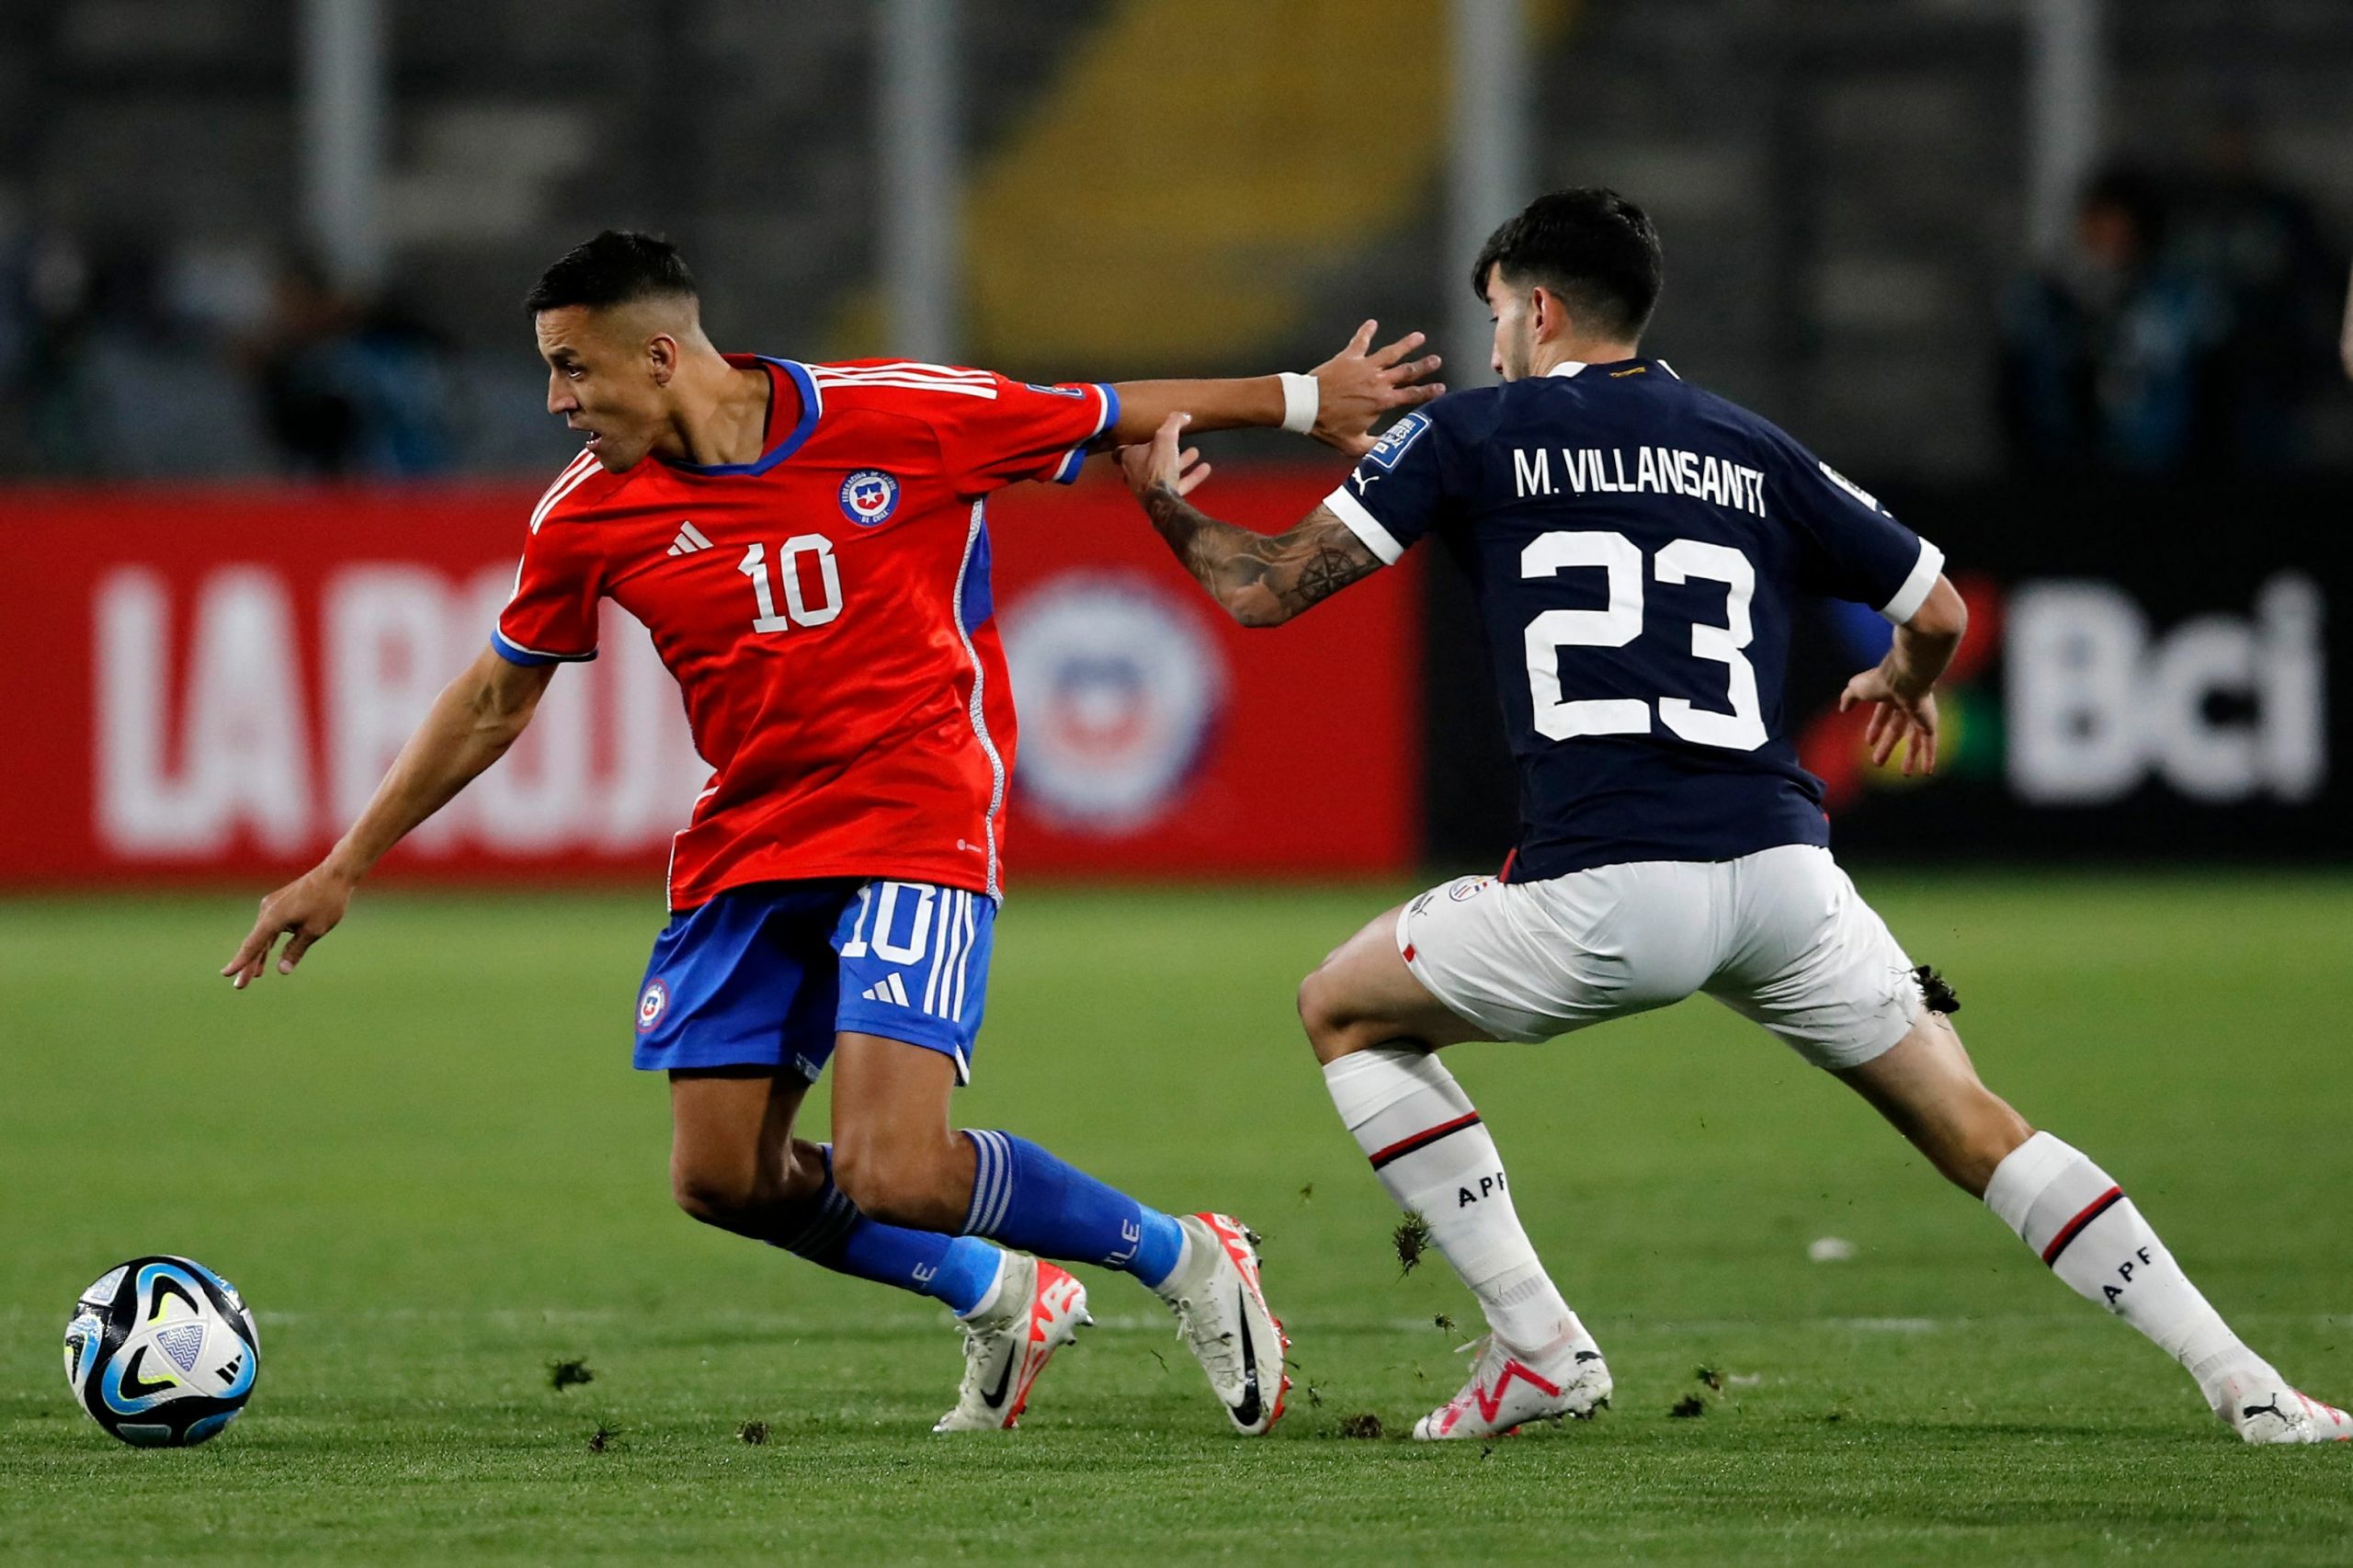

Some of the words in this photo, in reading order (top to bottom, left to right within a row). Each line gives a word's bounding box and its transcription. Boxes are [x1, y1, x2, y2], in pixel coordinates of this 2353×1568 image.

[1513, 447, 1561, 498] M.
[1562, 447, 1768, 518] VILLANSANTI
[737, 533, 844, 633] 10
[1519, 529, 1769, 753] 23
[97, 562, 317, 857] LA
[839, 881, 938, 966] 10
[1459, 1171, 1505, 1209] APF
[2101, 1245, 2152, 1305] APF
